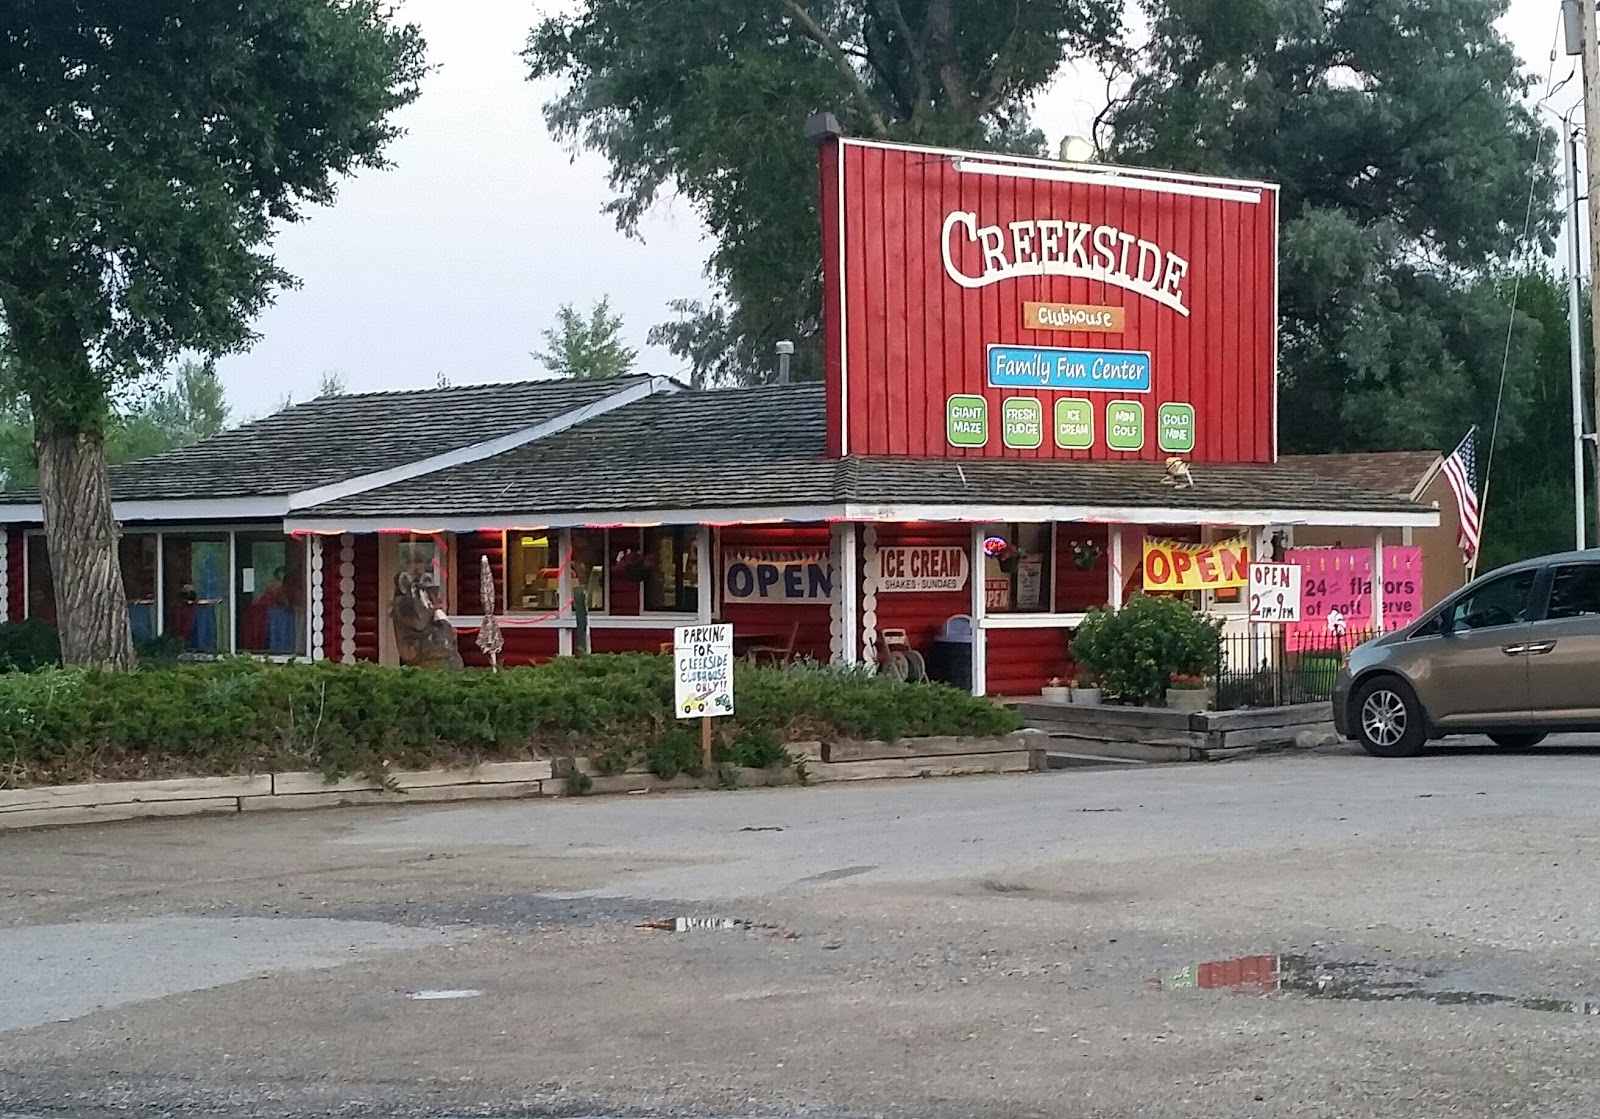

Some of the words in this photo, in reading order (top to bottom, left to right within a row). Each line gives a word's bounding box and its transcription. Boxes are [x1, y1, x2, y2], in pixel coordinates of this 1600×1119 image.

[941, 210, 1190, 317] CREEKSIDE
[1037, 306, 1113, 328] Clubhouse
[996, 353, 1050, 383] Family
[1056, 357, 1087, 379] Fun
[1092, 358, 1145, 380] Center
[952, 406, 984, 419] GIANT
[1006, 408, 1037, 421] FRESH
[1067, 409, 1081, 421] ICE
[1115, 410, 1135, 422] MINI
[1163, 414, 1188, 426] GOLD
[953, 421, 982, 434] MAZE
[1007, 422, 1039, 435] FUDGE
[1060, 423, 1088, 436] CREAM
[1113, 424, 1137, 437] GOLF
[1165, 428, 1188, 440] MINE
[880, 549, 905, 578] ICE
[911, 549, 961, 578] CREAM
[1145, 548, 1248, 584] OPEN
[727, 563, 833, 598] OPEN
[1255, 566, 1290, 588] OPEN
[885, 580, 916, 590] SHAKES
[922, 579, 957, 589] SUNDAES
[1305, 580, 1327, 597] 24
[1350, 577, 1414, 595] flaors
[985, 590, 1008, 608] PEN
[1306, 601, 1322, 616] of
[1382, 600, 1412, 614] erve
[684, 626, 725, 644] PARKING
[693, 644, 714, 656] FOR
[680, 654, 728, 671] CREEKSIDE
